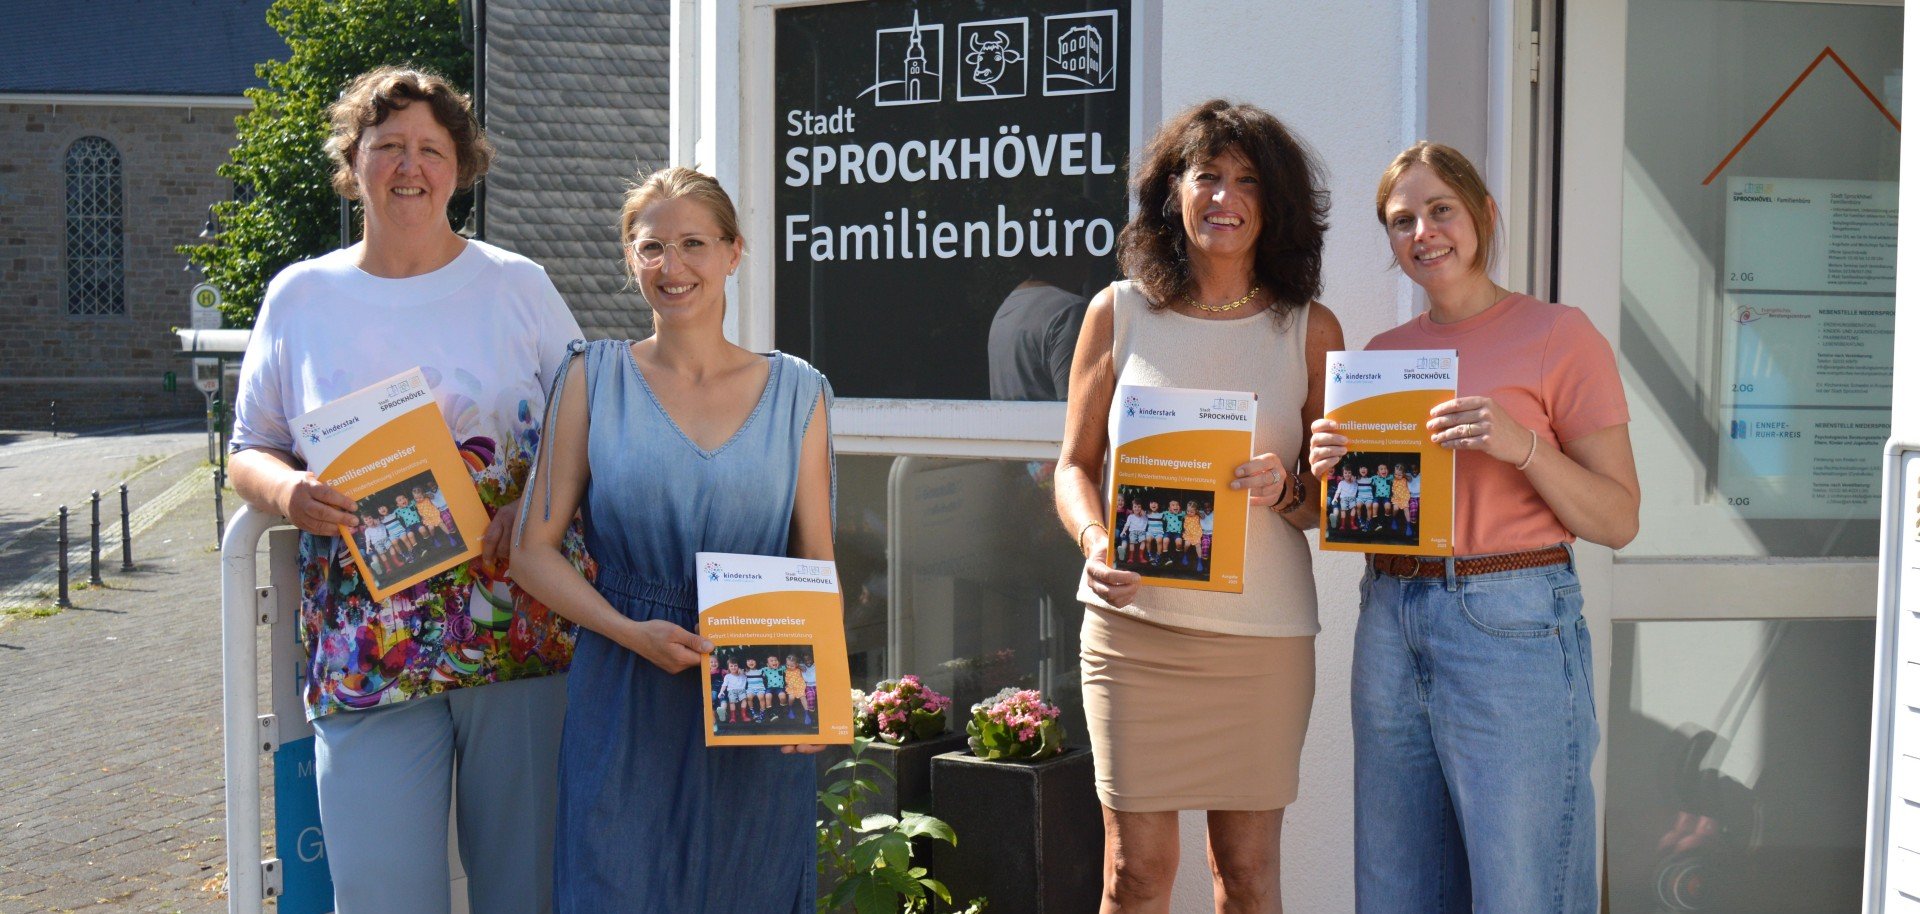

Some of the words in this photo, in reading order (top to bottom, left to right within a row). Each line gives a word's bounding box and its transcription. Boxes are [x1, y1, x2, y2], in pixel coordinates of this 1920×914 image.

[786, 105, 855, 137] Stadt
[784, 124, 1116, 187] SPROCKHÖVEL
[1733, 195, 1772, 203] SPROCKHÖVEL
[785, 204, 1115, 262] Familienbüro
[1741, 272, 1754, 282] OG
[1403, 372, 1450, 380] SPROCKHÖVEL
[380, 389, 426, 412] SPROCKHÖVEL
[1139, 407, 1176, 417] kinderstark
[1199, 411, 1247, 421] SPROCKHÖVEL
[321, 416, 360, 436] kinderstark
[1336, 420, 1417, 433] milienwegweiser
[1755, 421, 1789, 429] ENNEPE-
[326, 445, 416, 487] Familienwegweiser
[1120, 454, 1213, 469] Familienwegweiser
[723, 572, 763, 580] kinderstark
[785, 576, 833, 585] SPROCKHÖVEL
[707, 616, 806, 628] Familienwegweiser
